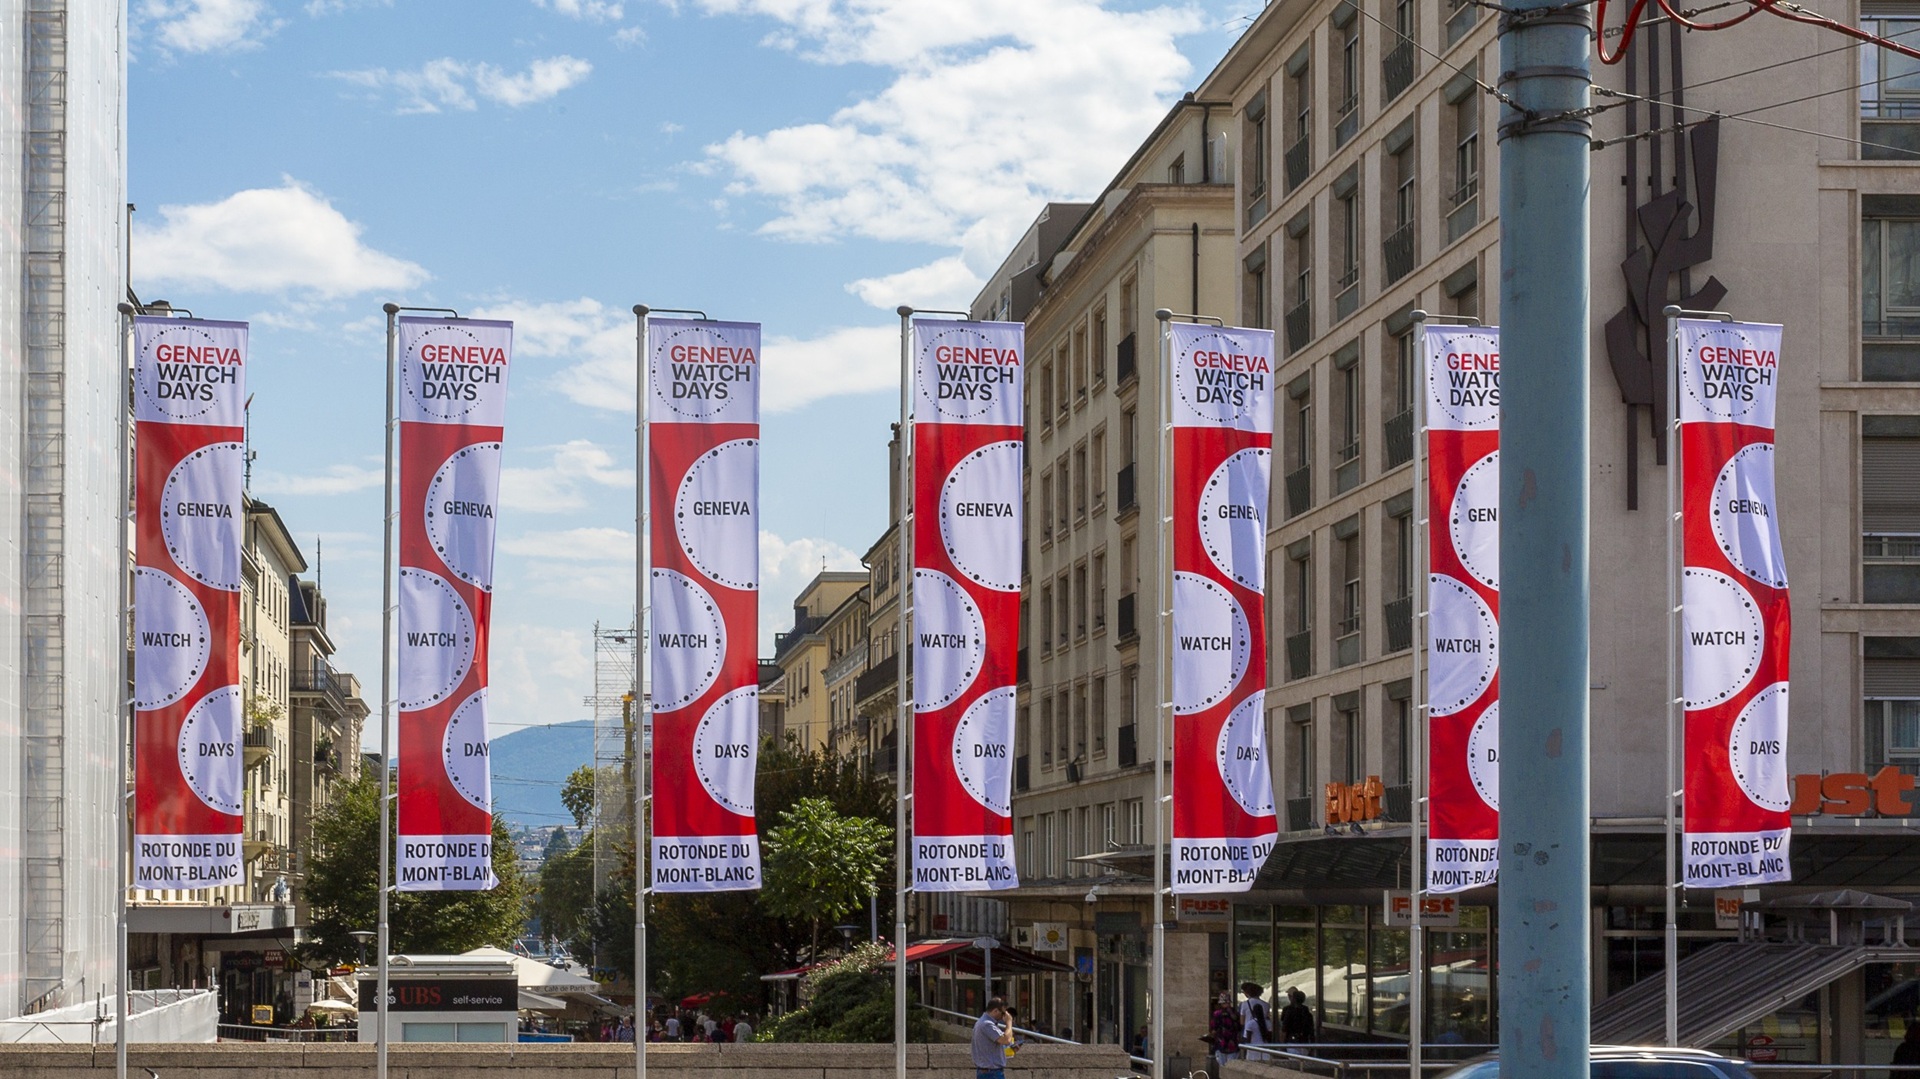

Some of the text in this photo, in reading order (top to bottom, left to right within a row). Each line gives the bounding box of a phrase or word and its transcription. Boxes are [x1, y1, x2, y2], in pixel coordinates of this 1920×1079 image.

[156, 344, 242, 366] GENEVA
[421, 345, 507, 365] GENEVA
[671, 345, 756, 364] GENEVA
[936, 346, 1019, 366] GENEVA
[1194, 350, 1269, 373] GENEVA
[1447, 354, 1500, 371] GENE
[1700, 347, 1776, 368] GENEVA
[157, 364, 236, 384] WATCH
[421, 364, 500, 384] WATCH
[672, 364, 751, 382] WATCH
[936, 364, 1014, 384] WATCH
[1195, 368, 1264, 390] WATCH
[1701, 364, 1771, 386] WATCH
[157, 382, 214, 402] DAYS
[421, 382, 477, 400] DAYS
[672, 381, 728, 400] DAYS
[937, 383, 992, 401] DAYS
[1196, 386, 1244, 406] DAYS
[1704, 382, 1753, 401] DAYS
[177, 502, 232, 519] GENEVA
[444, 501, 493, 519] GENEVA
[693, 501, 750, 516] GENEVA
[956, 502, 1013, 517] GENEVA
[1468, 508, 1496, 522] GEN
[1729, 500, 1769, 518] GENEVA
[142, 633, 191, 648] WATCH
[408, 633, 456, 648] WATCH
[659, 634, 708, 649] WATCH
[920, 634, 966, 648] WATCH
[1180, 637, 1231, 650] WATCH
[1436, 639, 1481, 653] WATCH
[1691, 632, 1745, 646] WATCH
[199, 743, 234, 756] DAYS
[464, 743, 490, 757] DAY
[714, 744, 749, 758] DAYS
[974, 744, 1006, 758] DAYS
[1750, 741, 1779, 755] DAYS
[1788, 766, 1915, 815] ust
[141, 842, 235, 858] ROTONDE DU
[405, 842, 492, 858] ROTONDE D
[659, 844, 750, 859] ROTONDE DU
[919, 844, 1005, 859] ROTONDE DU
[1181, 842, 1271, 861] ROTONDE DU
[1691, 837, 1783, 855] ROTONDE DU
[1436, 848, 1496, 863] ROTONDE
[139, 864, 238, 880] MONT-BLANC
[402, 865, 489, 881] MONT-BLAN
[657, 866, 754, 882] MONT-BLANC
[916, 866, 1011, 881] MONT-BLANC
[1178, 866, 1260, 883] MONT-BLA
[1688, 858, 1784, 879] MONT-BLANC
[1432, 869, 1500, 886] MONT-BLA
[1182, 899, 1230, 911] Fust
[598, 970, 617, 982] 90
[400, 986, 502, 1005] UBS self-service
